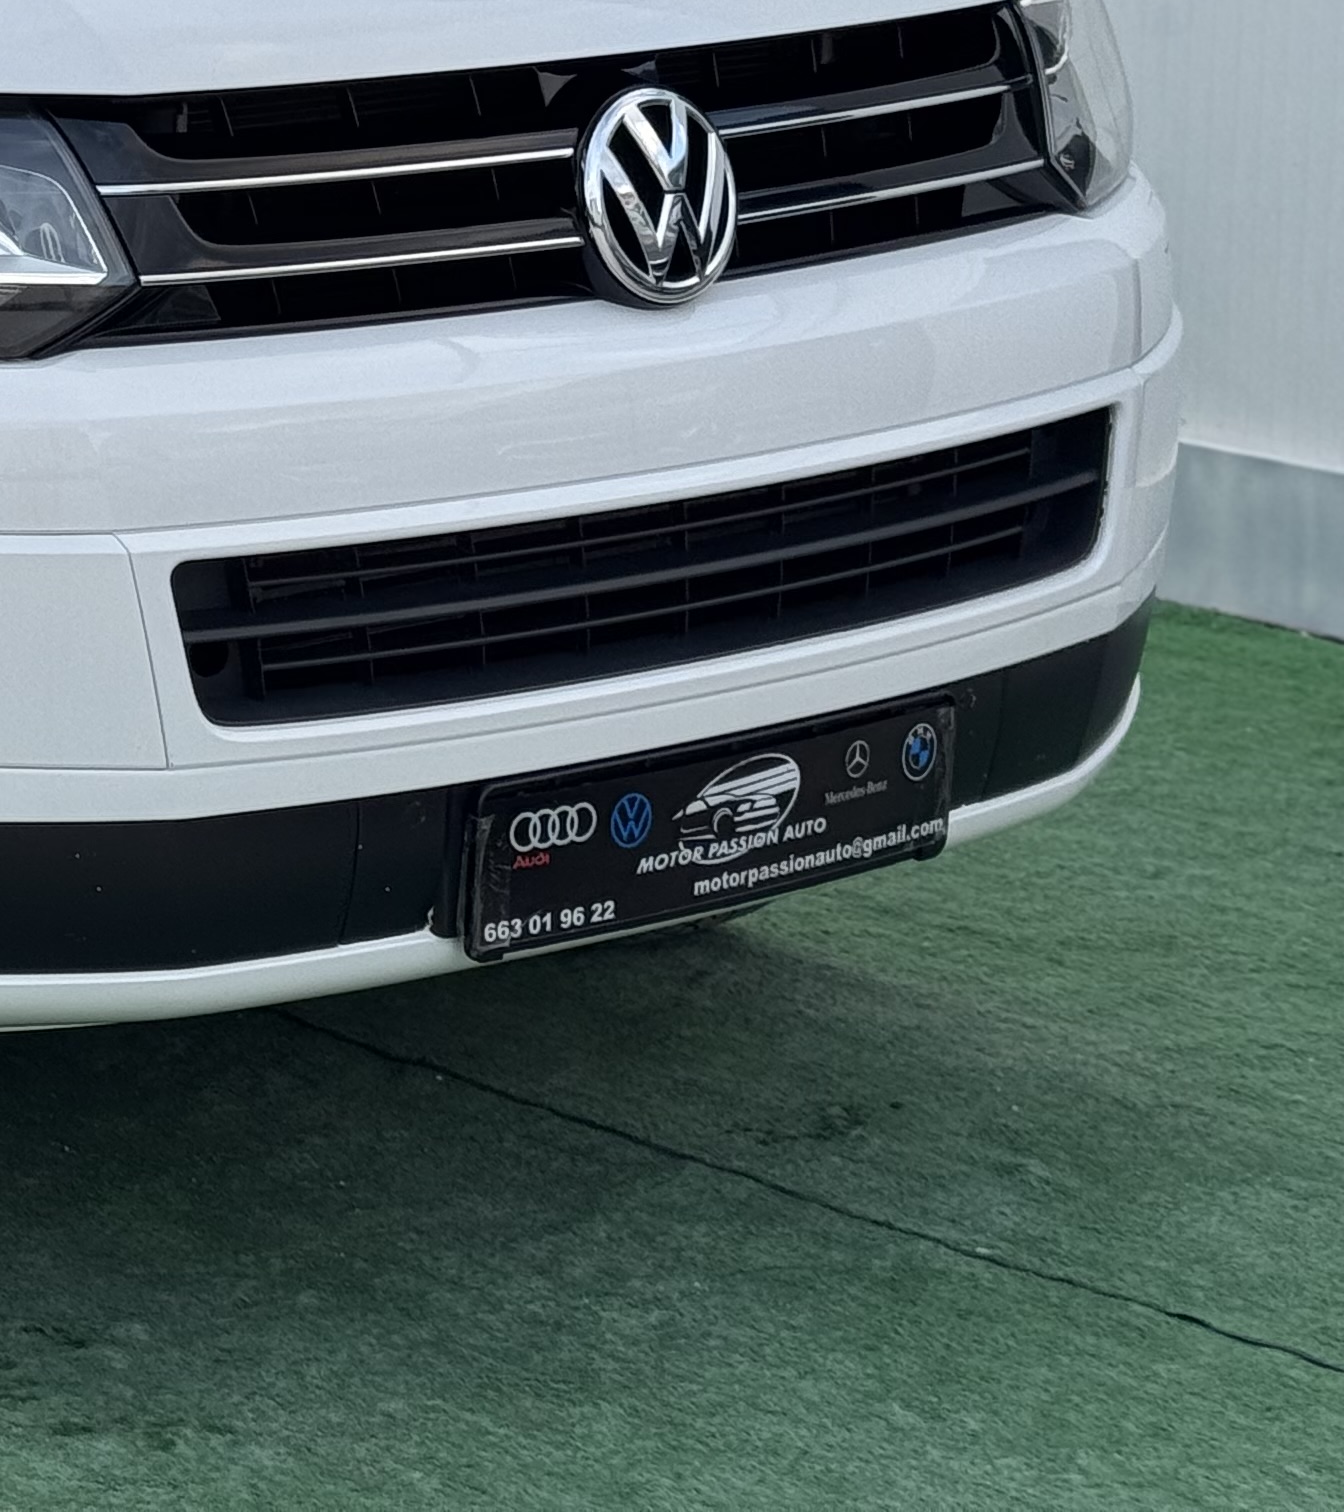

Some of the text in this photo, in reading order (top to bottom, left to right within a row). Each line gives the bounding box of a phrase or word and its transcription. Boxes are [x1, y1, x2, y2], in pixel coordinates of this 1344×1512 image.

[636, 817, 827, 874] MOTOR PASSION AUTO
[693, 817, 945, 896] motorpassionauto@gmail.com
[484, 900, 616, 942] 663 01 96 22
